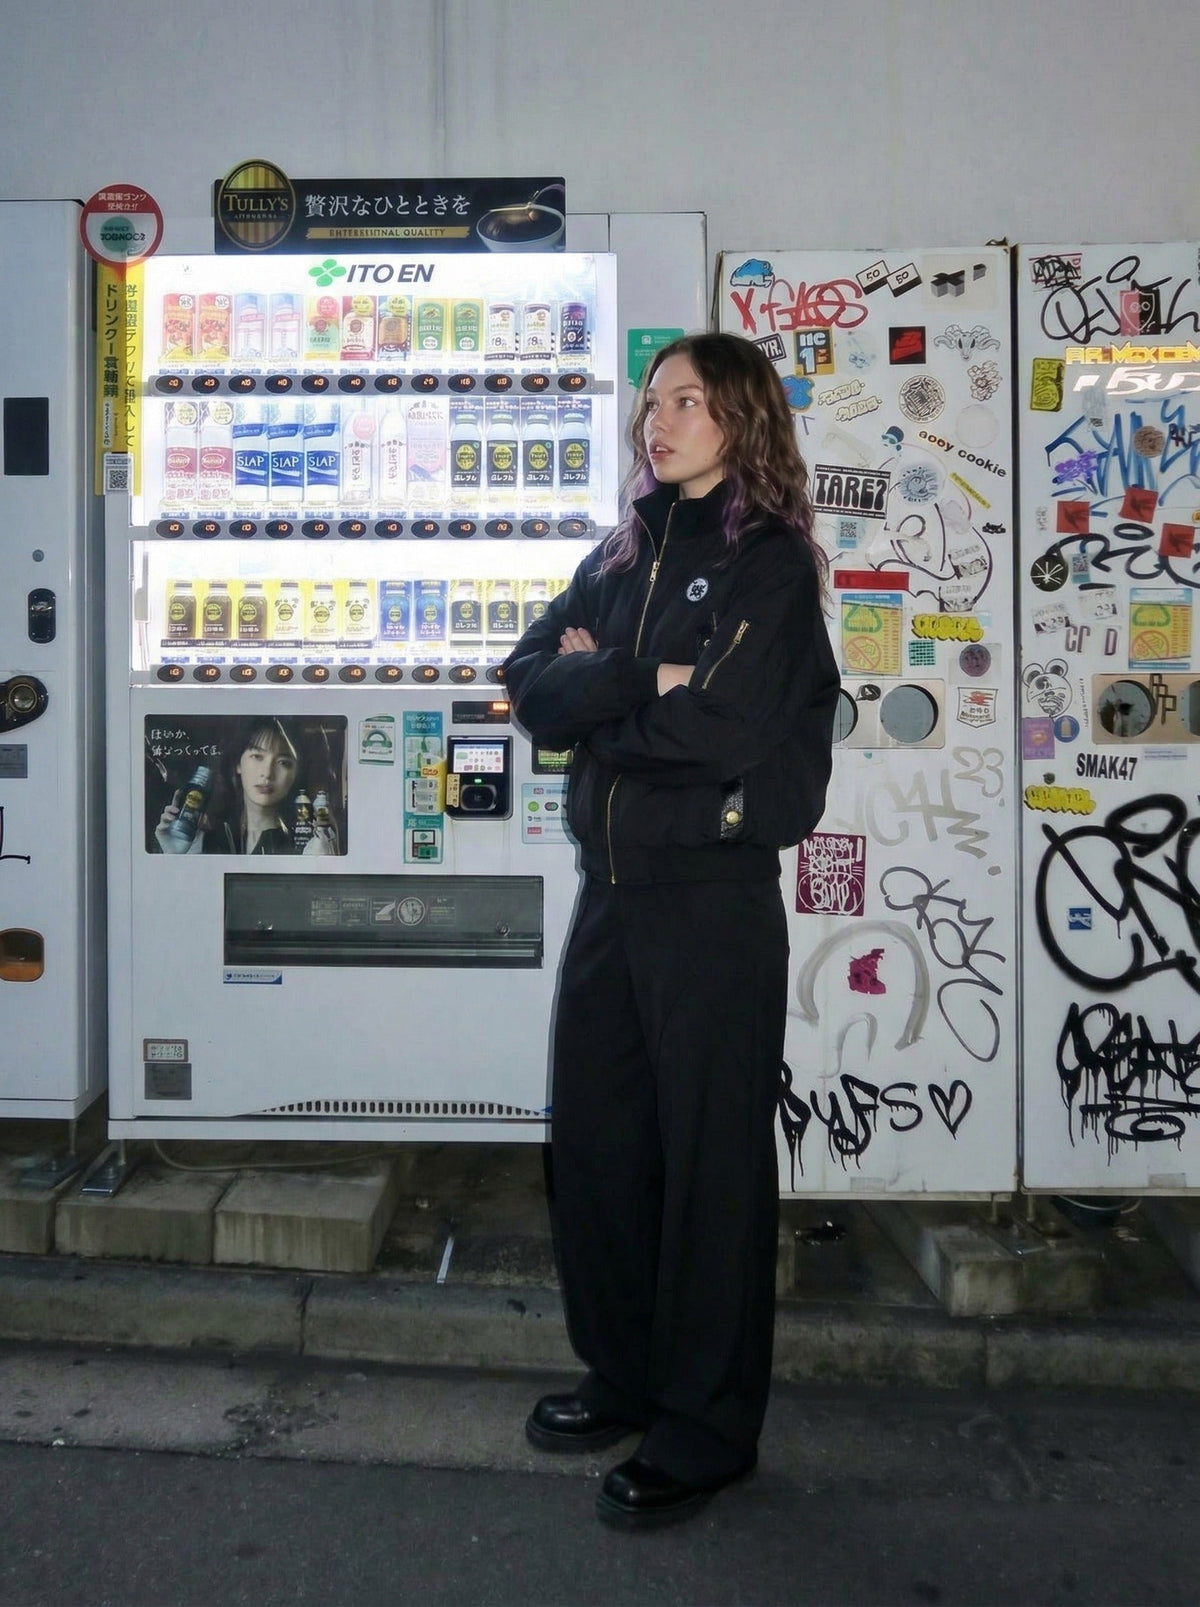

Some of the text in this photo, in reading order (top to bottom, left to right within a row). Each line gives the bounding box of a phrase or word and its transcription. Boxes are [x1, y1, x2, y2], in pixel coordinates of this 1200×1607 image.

[305, 194, 471, 218] 贅沢なひとときを
[346, 263, 435, 283] ITO EN
[958, 449, 1007, 478] cookie
[1076, 753, 1138, 781] SMAK47
